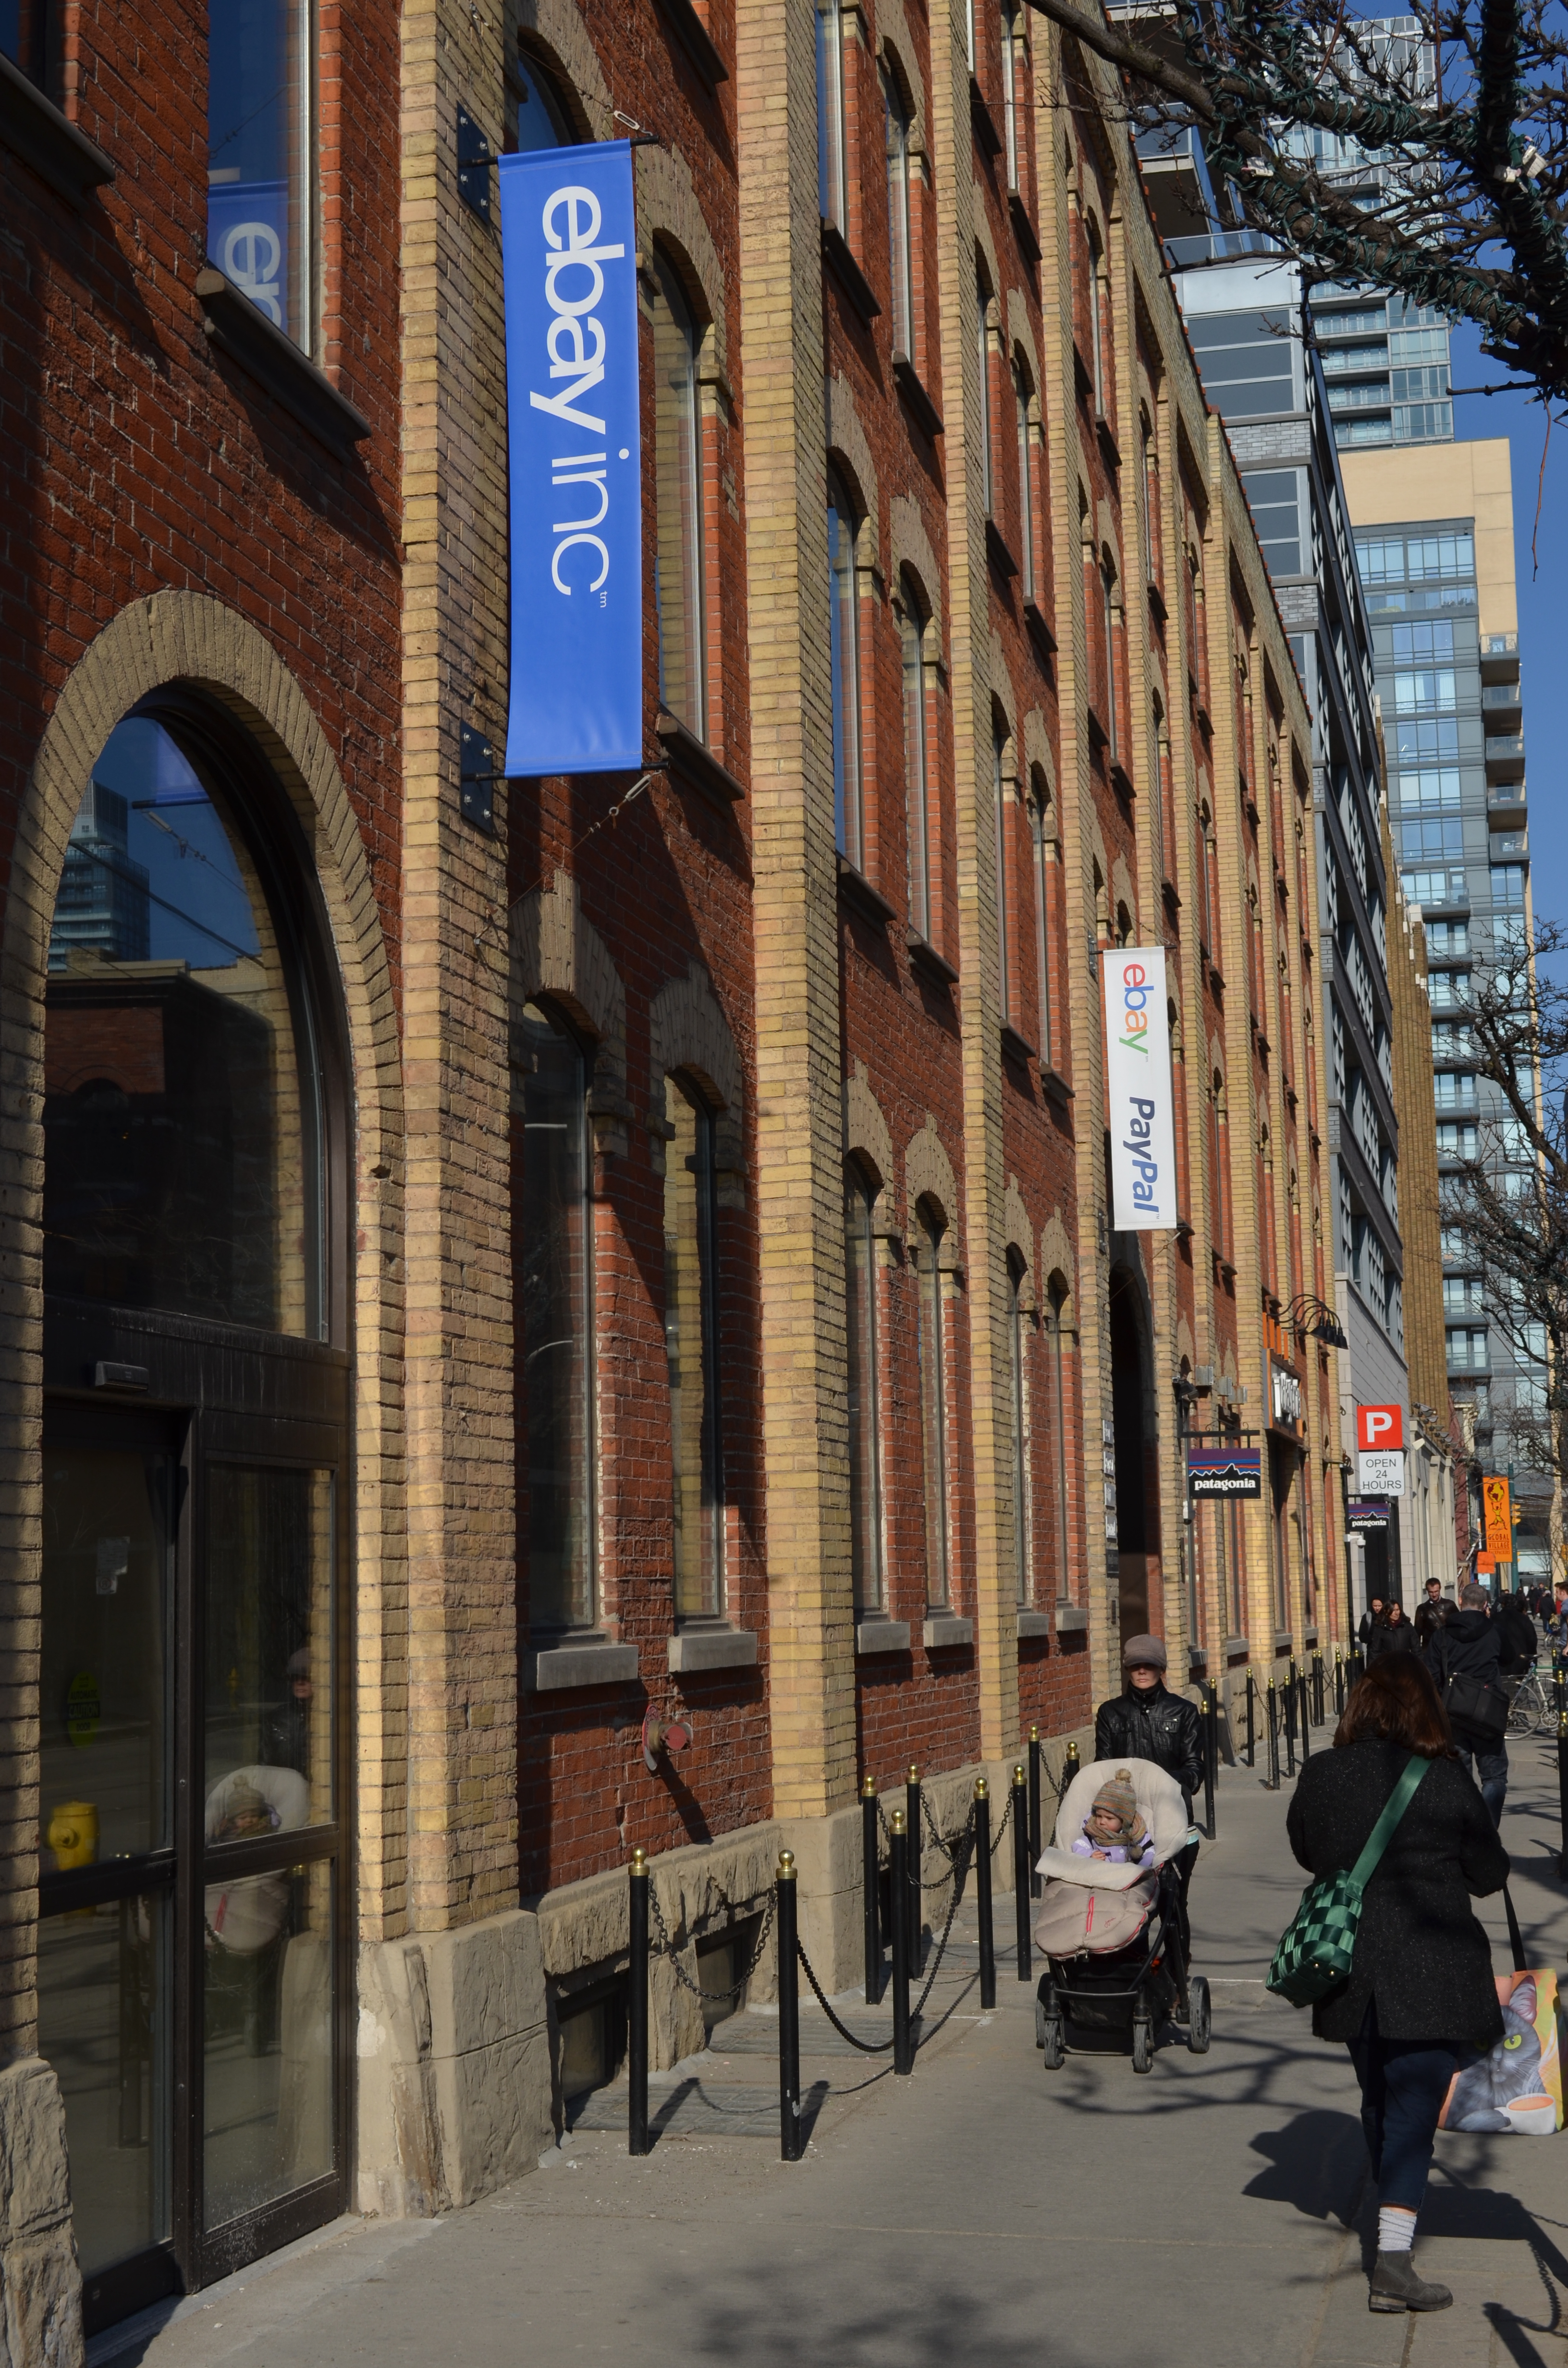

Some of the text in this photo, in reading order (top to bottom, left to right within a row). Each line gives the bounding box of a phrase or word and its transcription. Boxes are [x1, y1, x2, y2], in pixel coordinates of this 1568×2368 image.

[529, 185, 625, 435] ebay
[551, 448, 630, 596] inc
[1118, 963, 1154, 1054] ebay
[1122, 1096, 1159, 1213] PayPal
[1366, 1412, 1393, 1443] P
[1366, 1458, 1396, 1468] OPEN
[1375, 1470, 1388, 1479] 24
[1194, 1478, 1256, 1491] patagonia
[1362, 1480, 1402, 1490] HOURS
[1351, 1519, 1387, 1528] patagonia
[70, 1689, 98, 1700] AUTOMATIC
[68, 1703, 99, 1719] CAUTION
